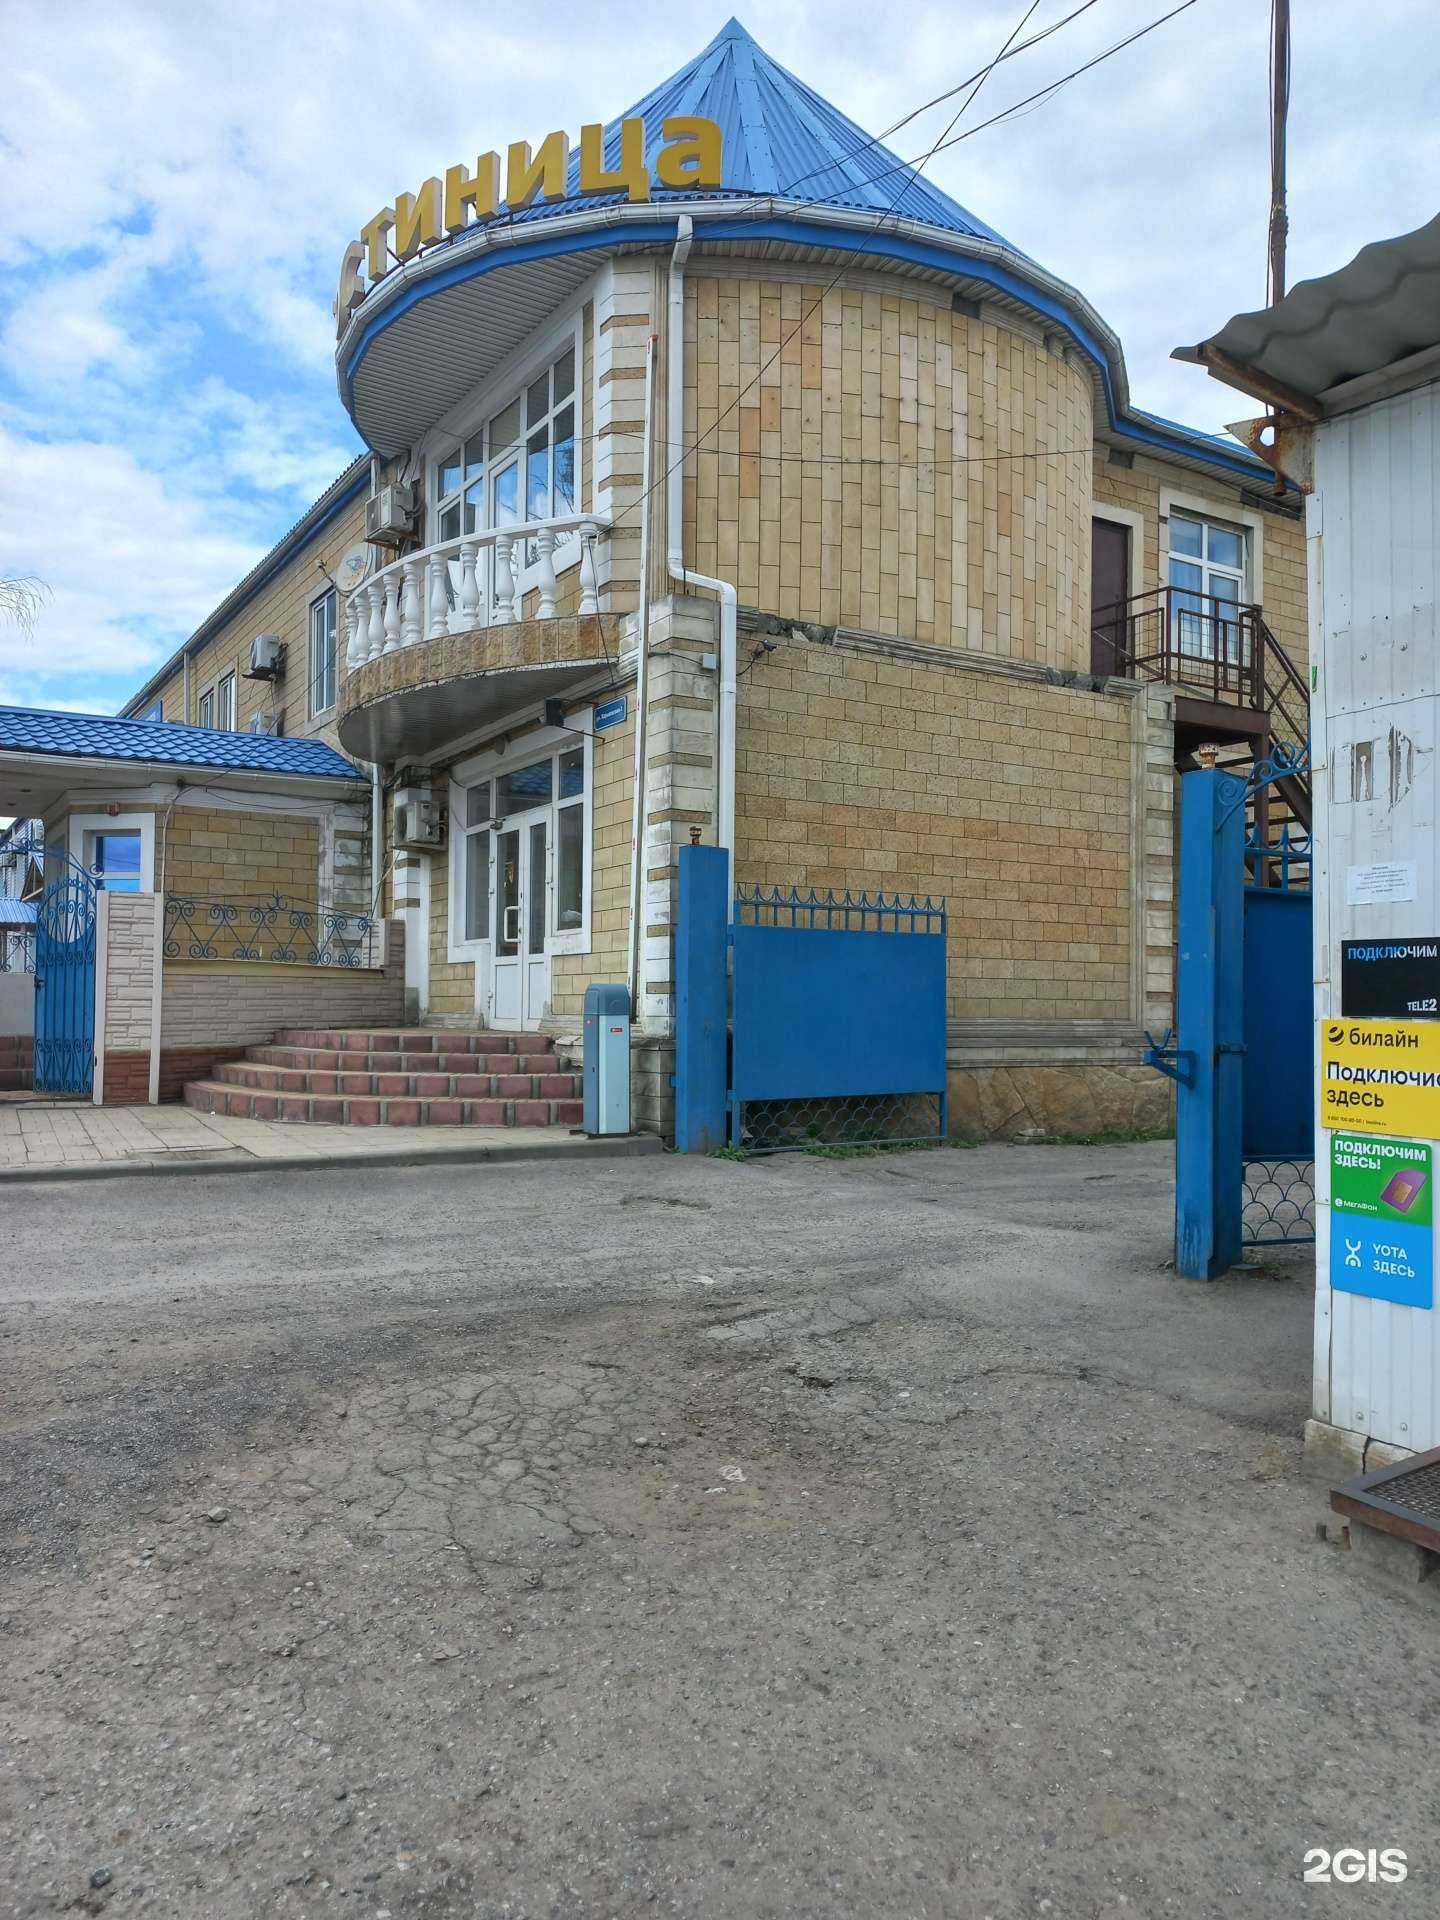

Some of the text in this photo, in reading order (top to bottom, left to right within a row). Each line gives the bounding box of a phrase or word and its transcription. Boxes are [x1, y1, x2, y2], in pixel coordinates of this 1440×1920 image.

[1348, 945, 1438, 961] ПОДКЛЮЧИМ
[1407, 998, 1438, 1012] TELE2
[1349, 1027, 1419, 1048] билайн
[1327, 1089, 1384, 1107] здесь
[1334, 1140, 1427, 1162] ПОДКЛЮЧИМ
[1334, 1154, 1381, 1170] ЗДЕСЬ!
[1372, 1243, 1408, 1260] YOTA
[1372, 1260, 1416, 1278] ЗДЕСЬ
